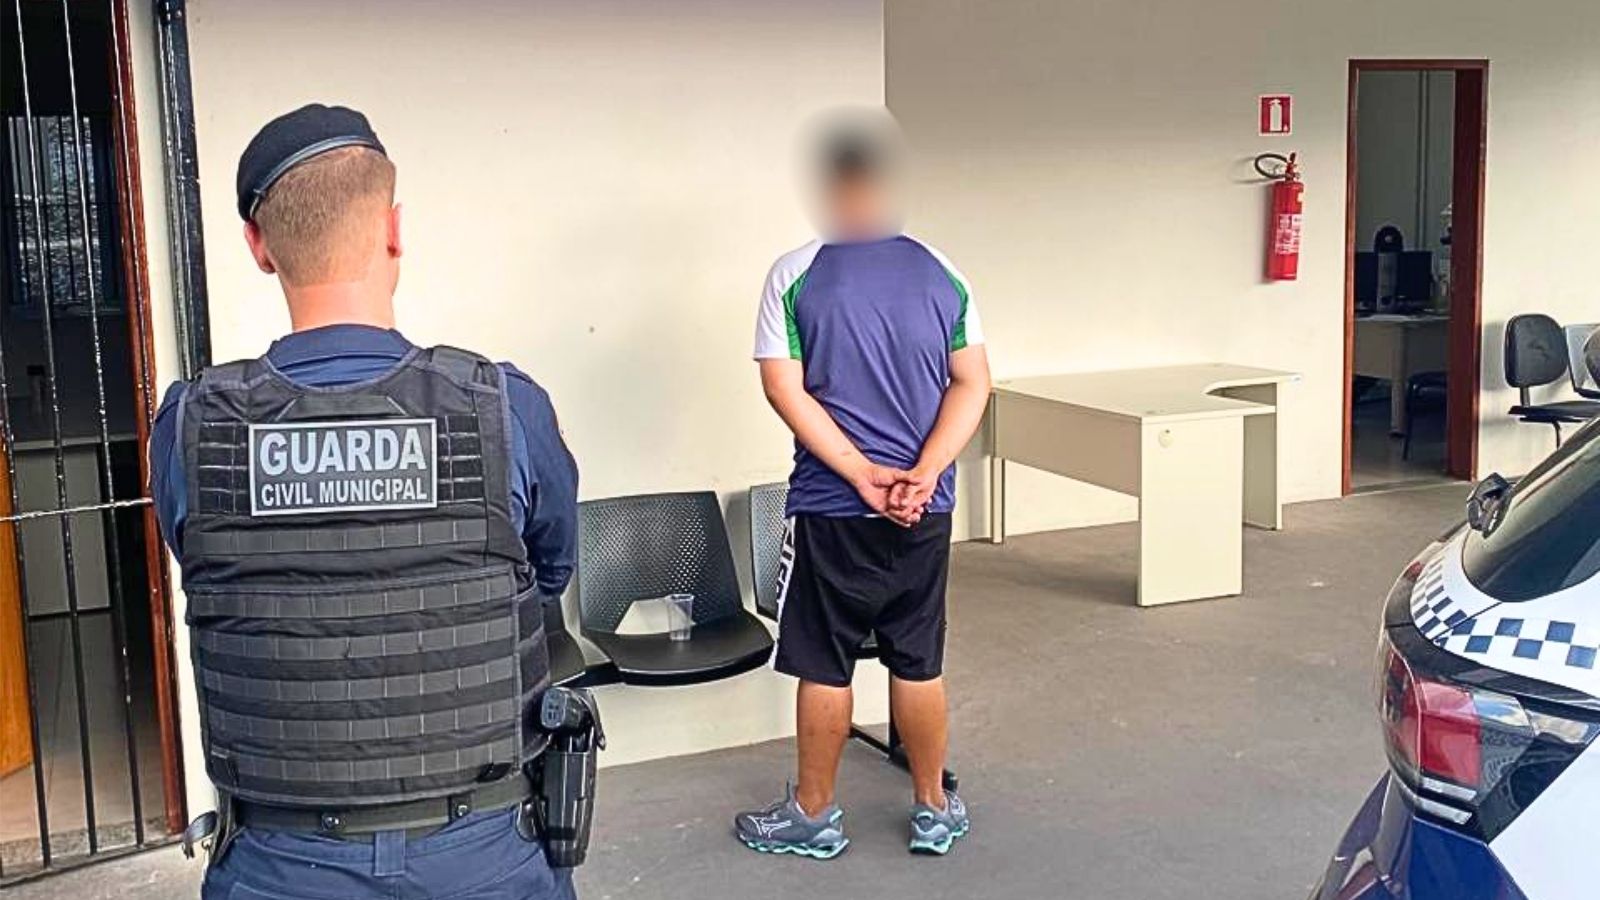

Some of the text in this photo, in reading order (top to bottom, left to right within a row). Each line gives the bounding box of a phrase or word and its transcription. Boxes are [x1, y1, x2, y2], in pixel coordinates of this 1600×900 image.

[259, 428, 427, 475] GUARDA
[261, 477, 427, 506] CIVIL MUNICIPAL
